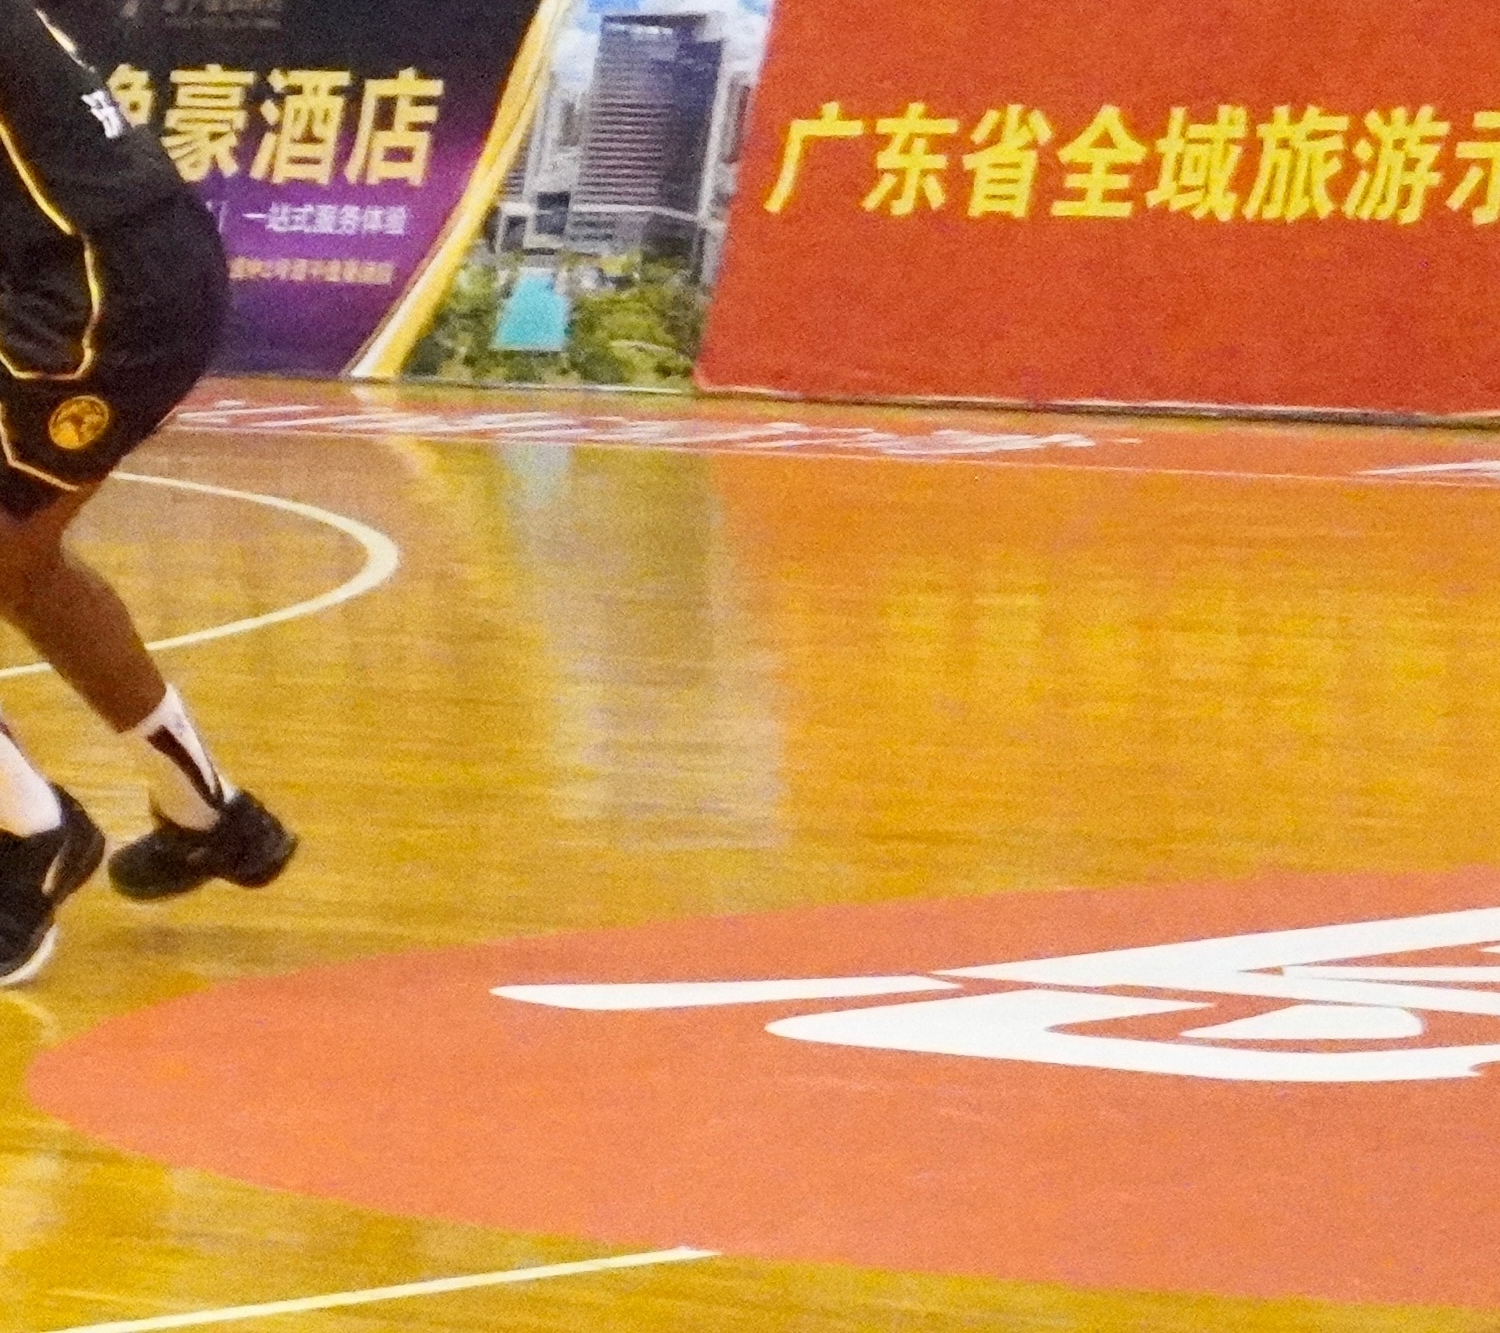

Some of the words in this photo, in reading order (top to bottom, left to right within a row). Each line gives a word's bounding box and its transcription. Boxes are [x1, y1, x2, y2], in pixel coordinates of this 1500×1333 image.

[243, 200, 407, 236] 一站式服务体验
